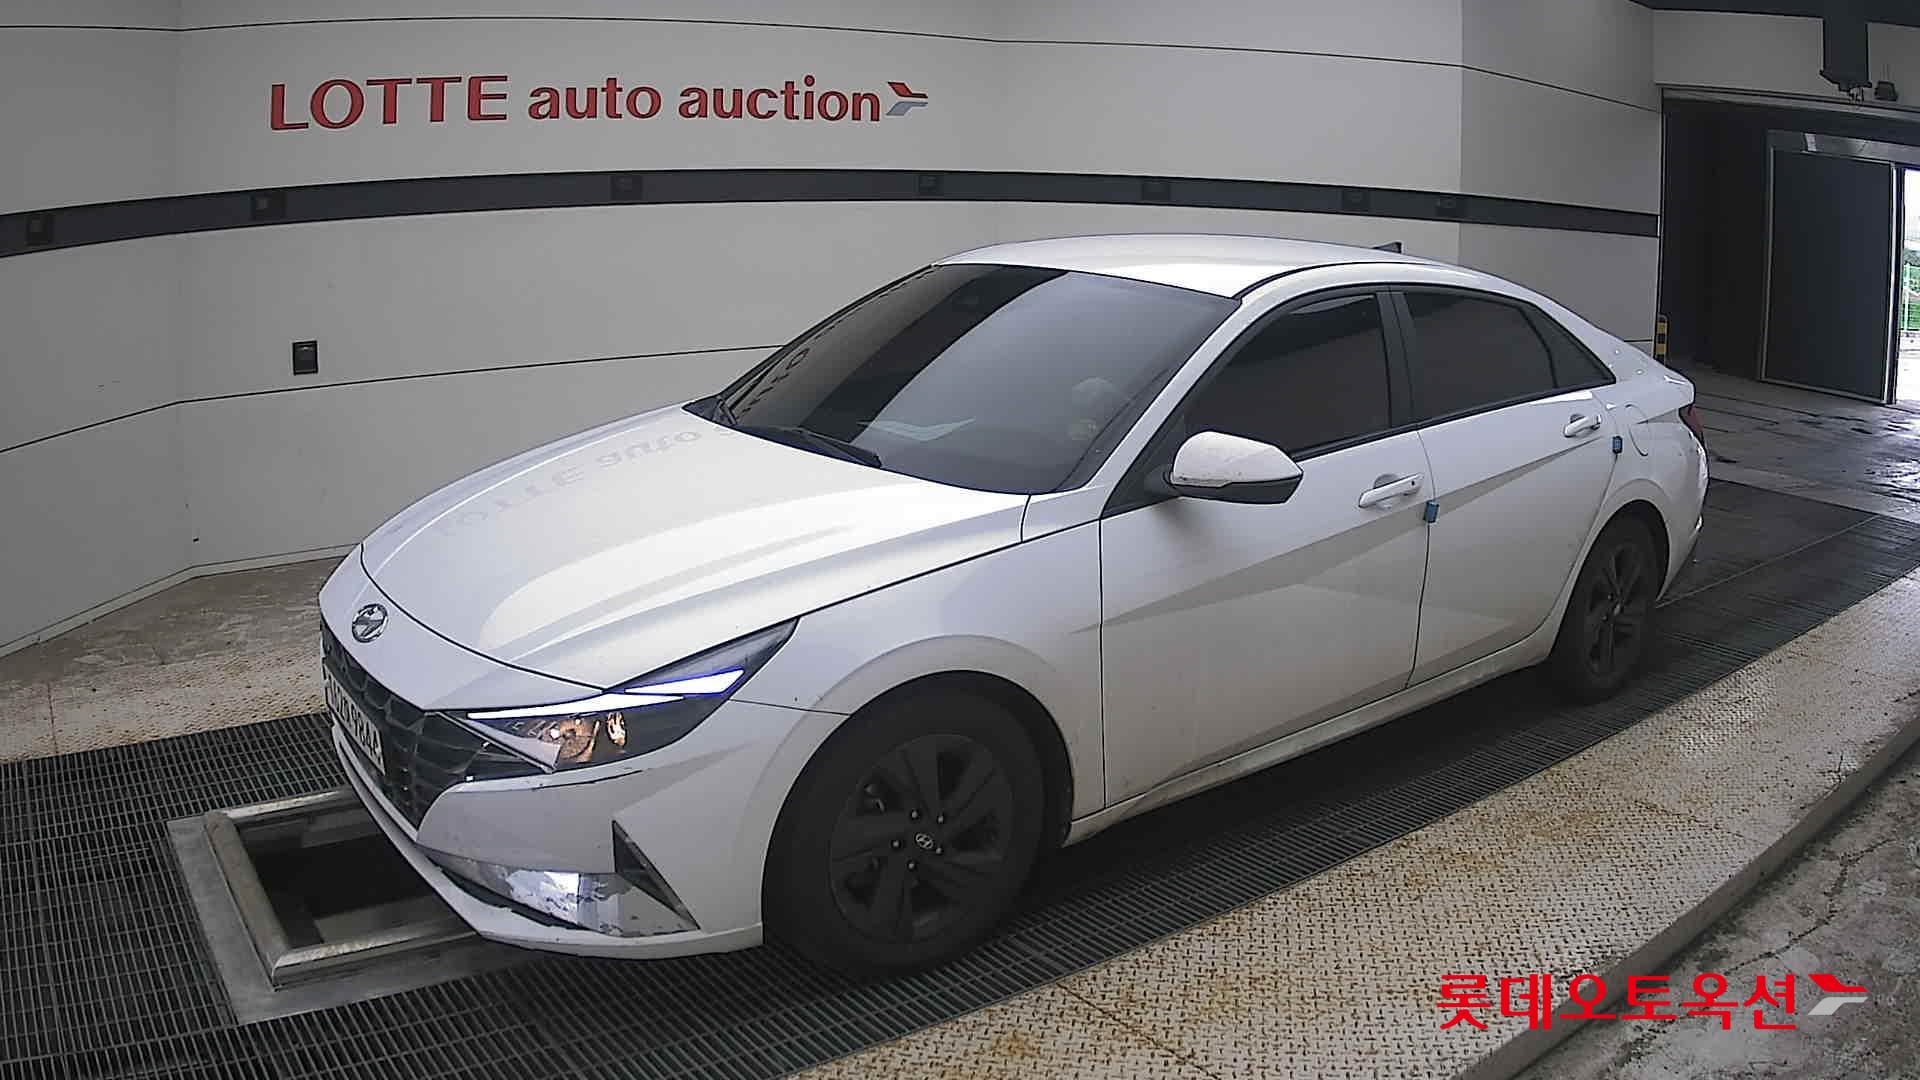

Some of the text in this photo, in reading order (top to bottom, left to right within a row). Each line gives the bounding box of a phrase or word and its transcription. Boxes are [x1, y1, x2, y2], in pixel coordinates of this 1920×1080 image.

[270, 75, 880, 130] LOTTE auto auction
